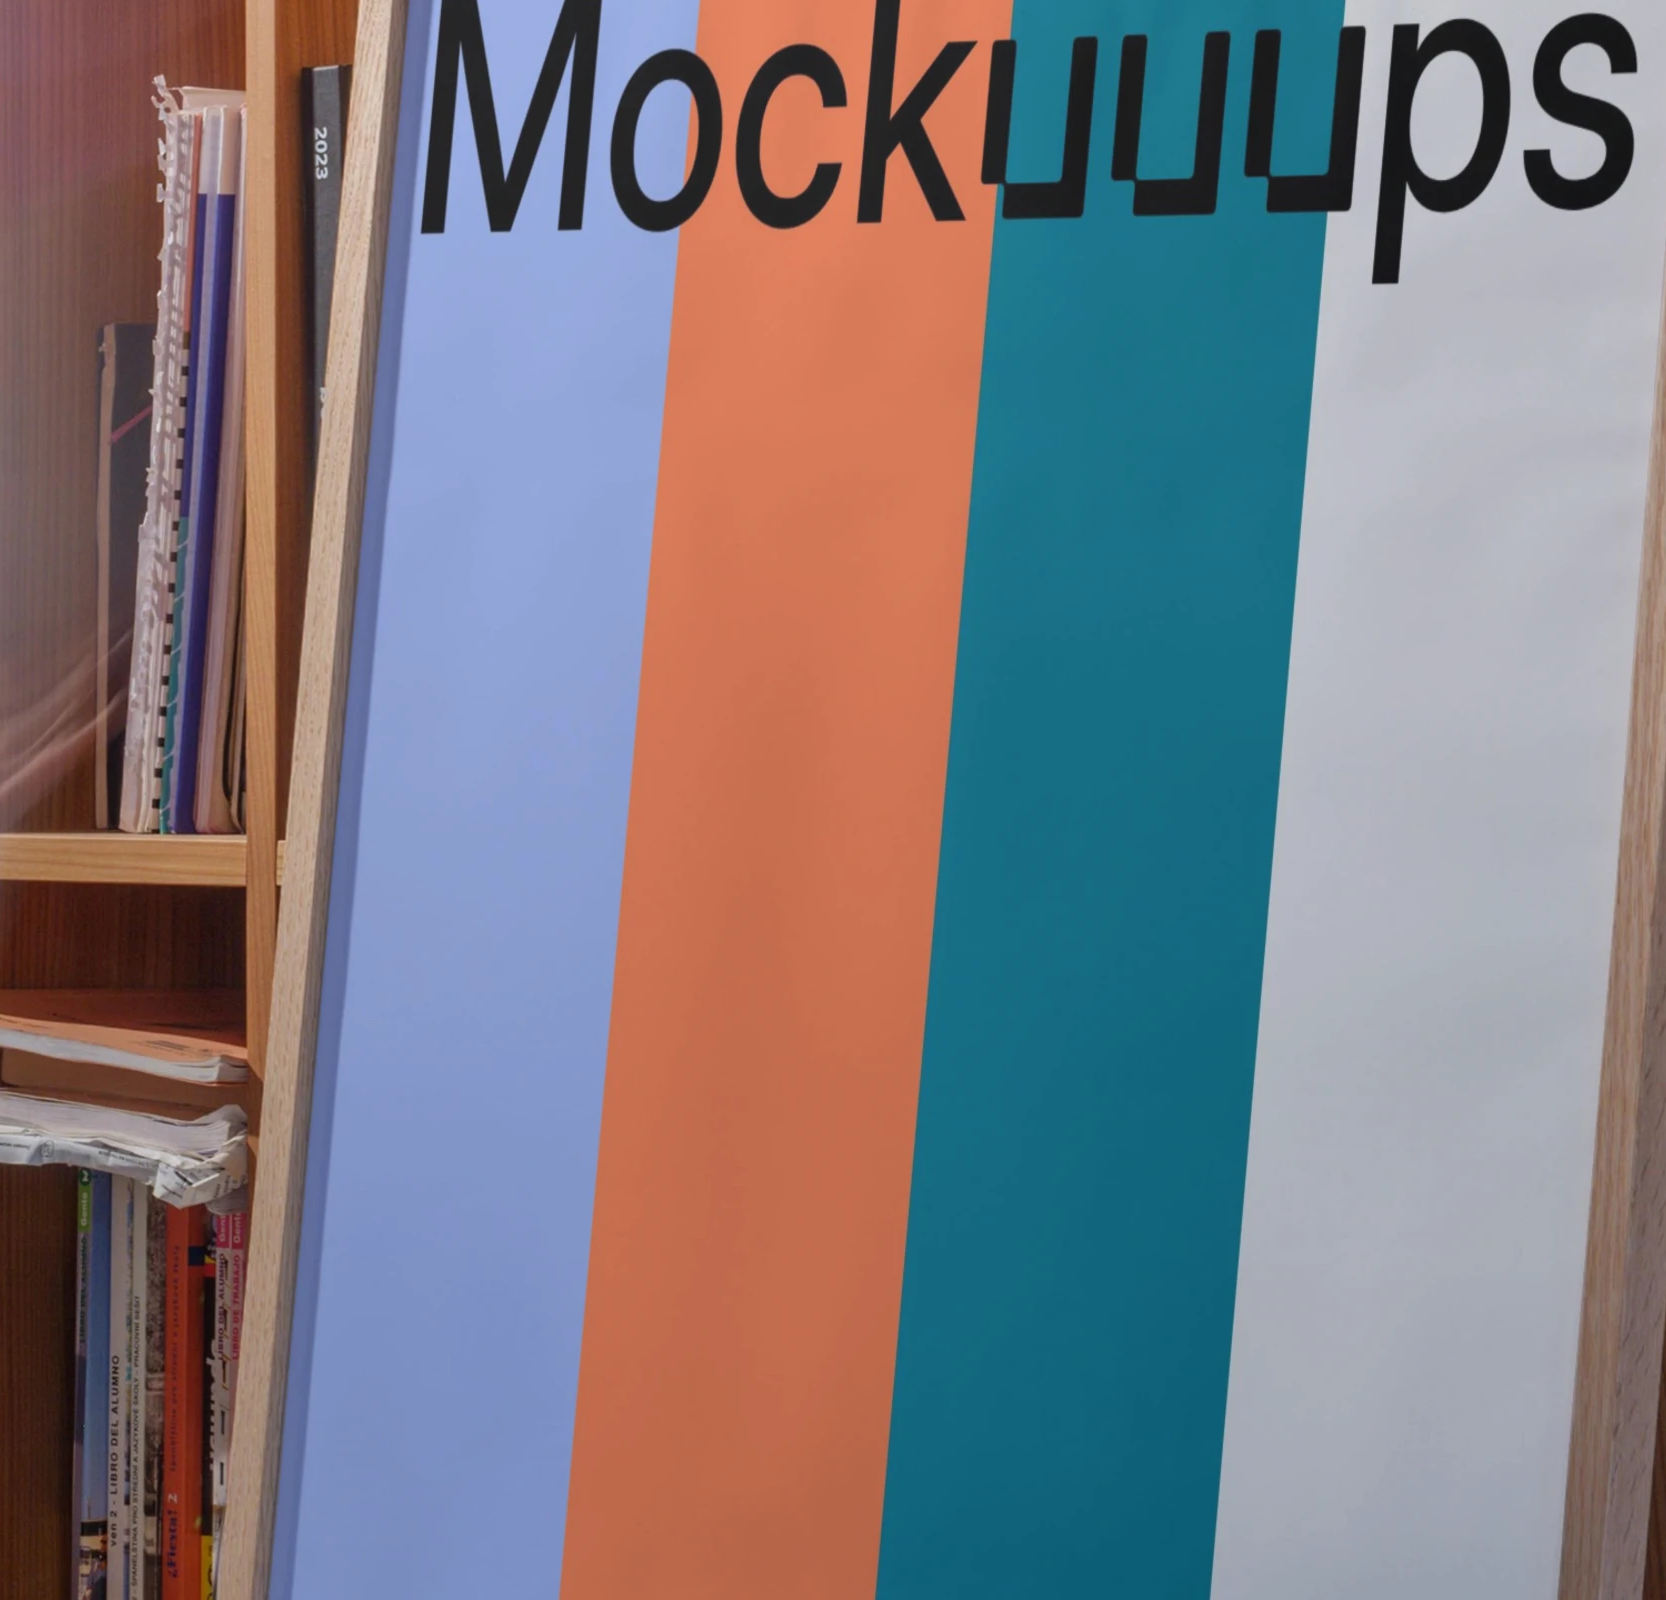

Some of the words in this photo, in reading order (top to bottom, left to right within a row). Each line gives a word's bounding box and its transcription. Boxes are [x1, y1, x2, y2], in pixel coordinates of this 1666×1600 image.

[314, 125, 329, 181] 2023
[233, 1254, 241, 1305] TRABAJO
[79, 1310, 87, 1343] LIBRO
[233, 1309, 240, 1323] DE
[111, 1355, 120, 1410] ALUMNO
[110, 1418, 119, 1447] DEL
[109, 1452, 119, 1495] LIBRO
[167, 1493, 178, 1503] 2
[110, 1510, 118, 1519] 2
[110, 1518, 118, 1547] ven
